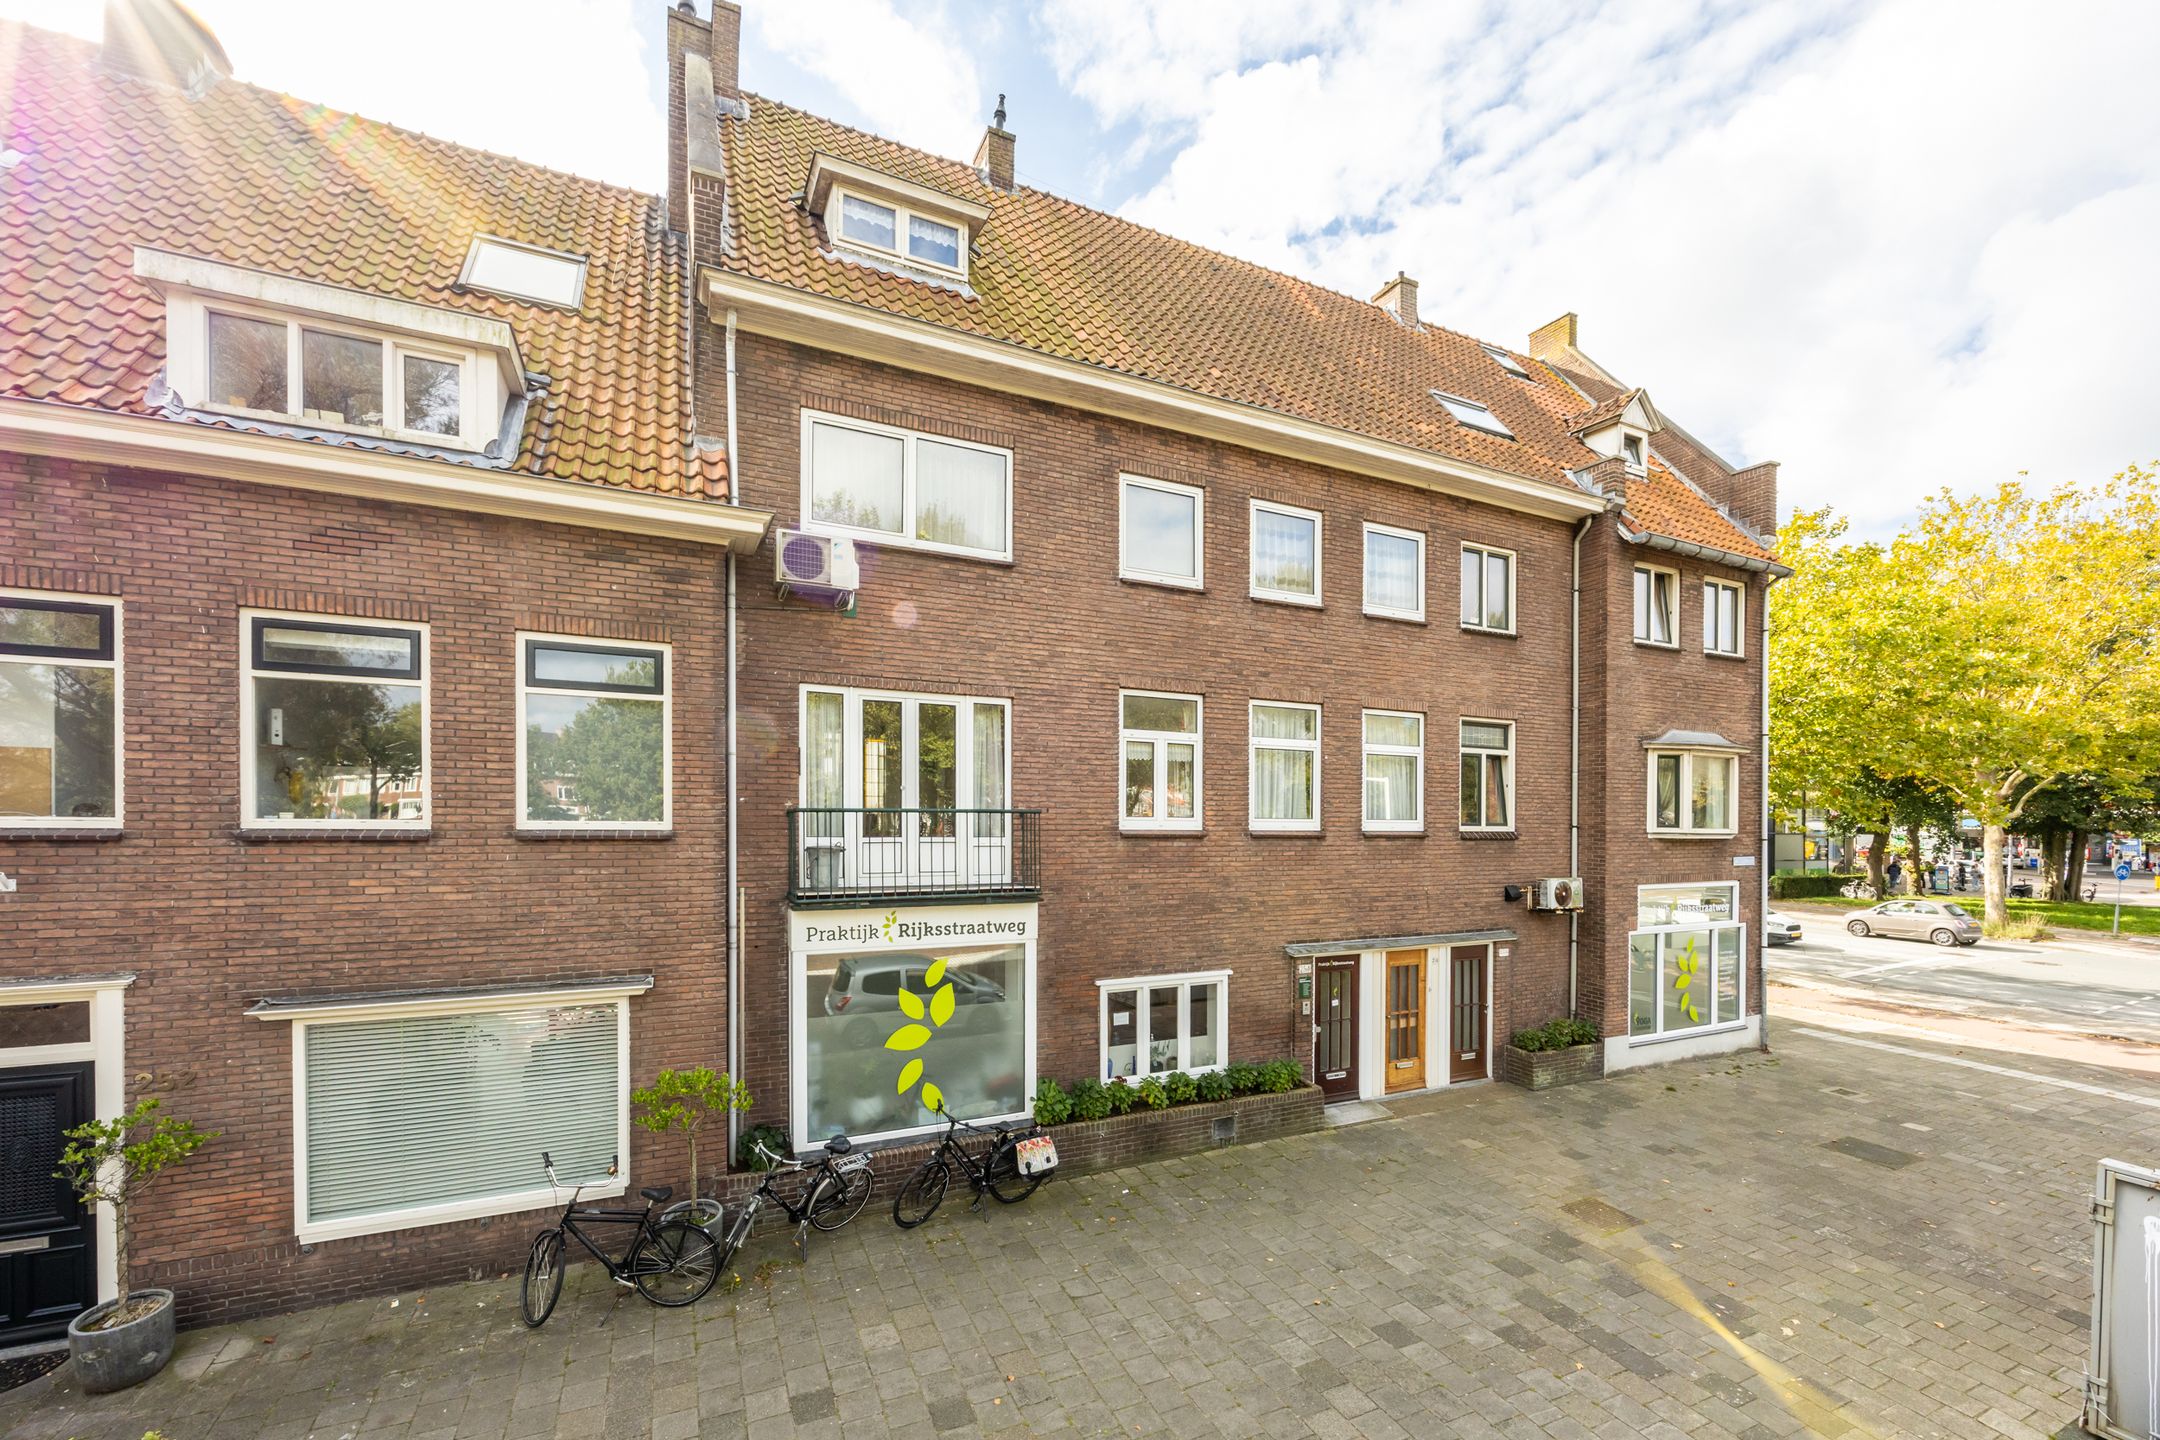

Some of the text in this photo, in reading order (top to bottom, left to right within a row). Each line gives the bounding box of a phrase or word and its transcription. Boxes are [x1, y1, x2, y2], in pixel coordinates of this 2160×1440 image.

[806, 920, 1027, 943] Praktijk Rijksstraatweg
[131, 1069, 198, 1094] 252
